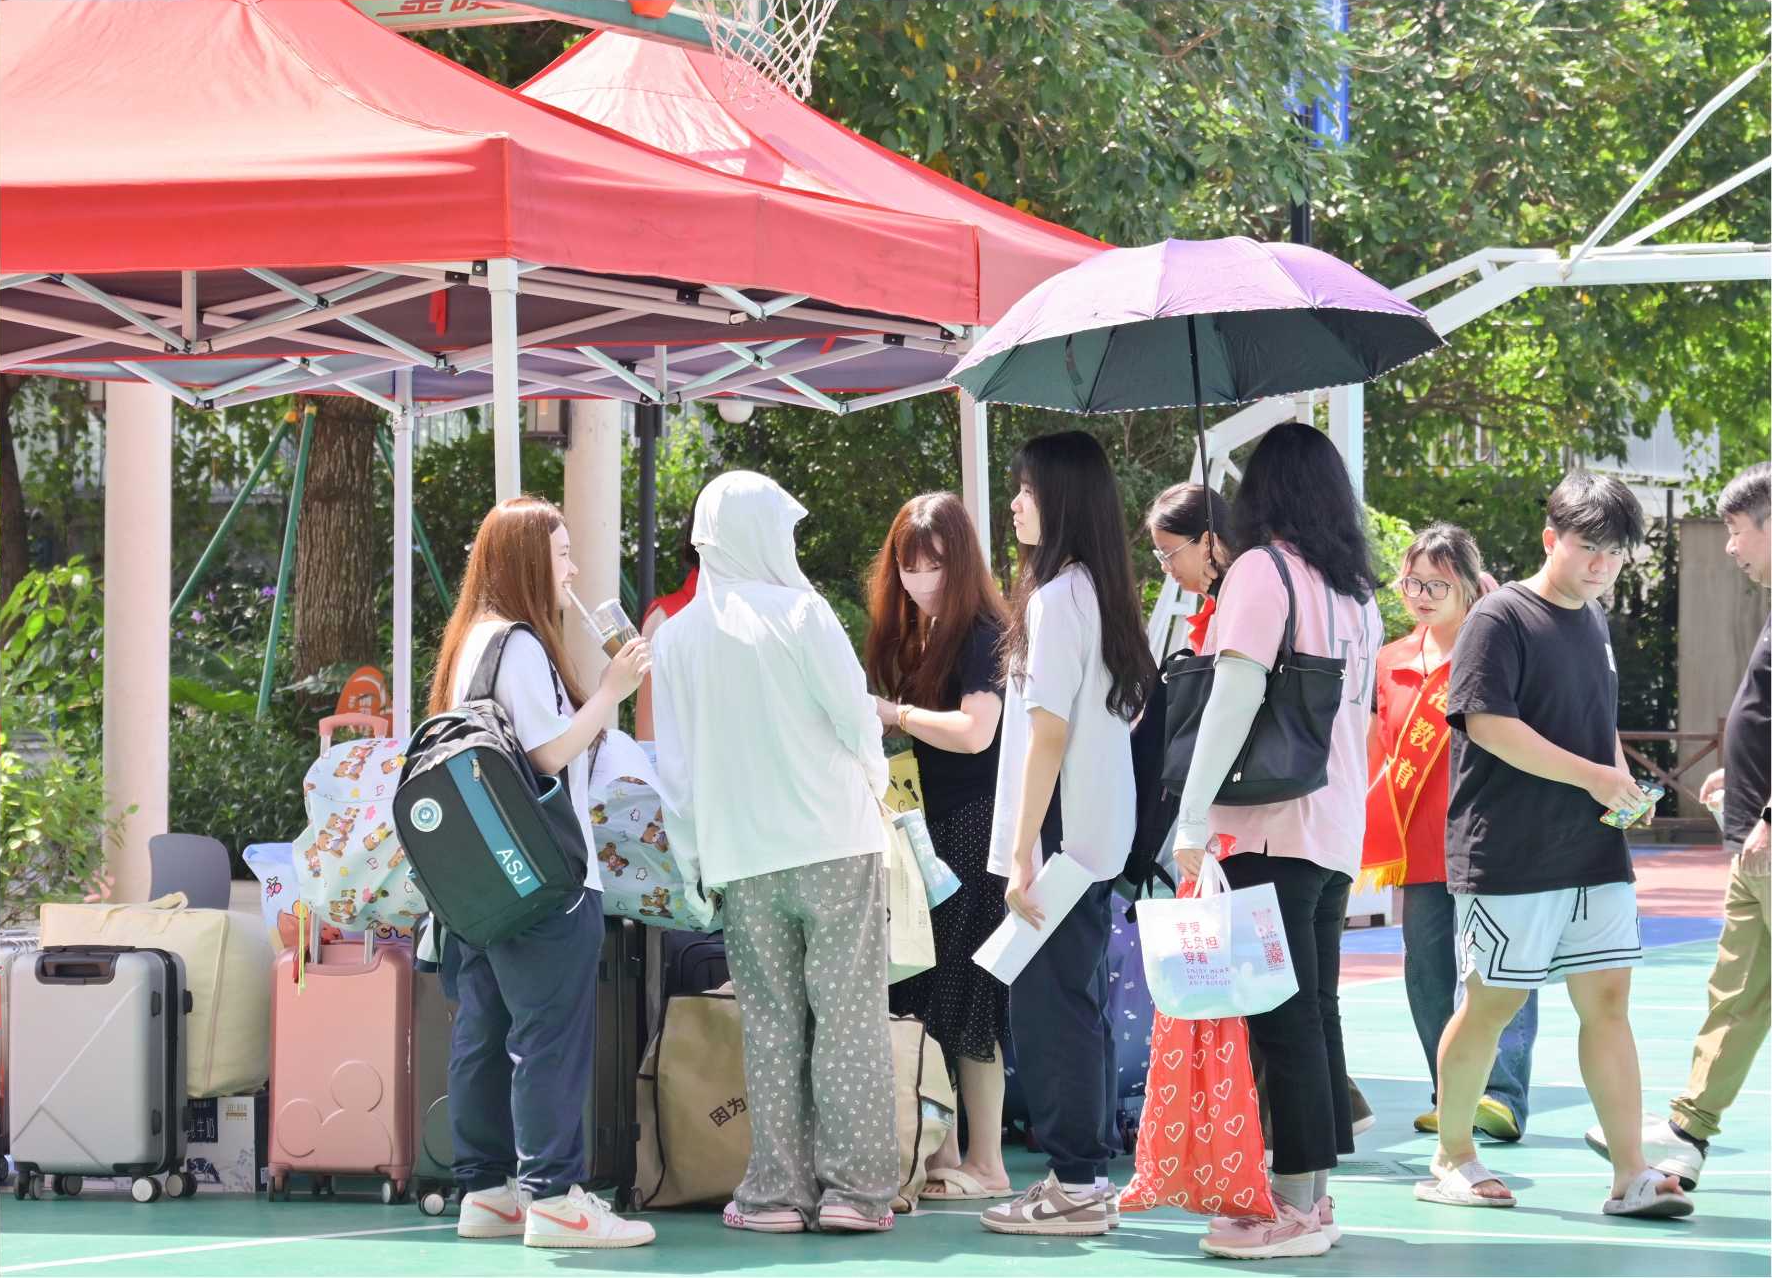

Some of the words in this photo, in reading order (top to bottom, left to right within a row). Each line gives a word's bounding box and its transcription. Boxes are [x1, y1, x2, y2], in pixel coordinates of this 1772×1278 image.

[495, 848, 531, 886] ASJ
[1180, 936, 1220, 950] 无负担
[709, 1097, 747, 1128] 因为
